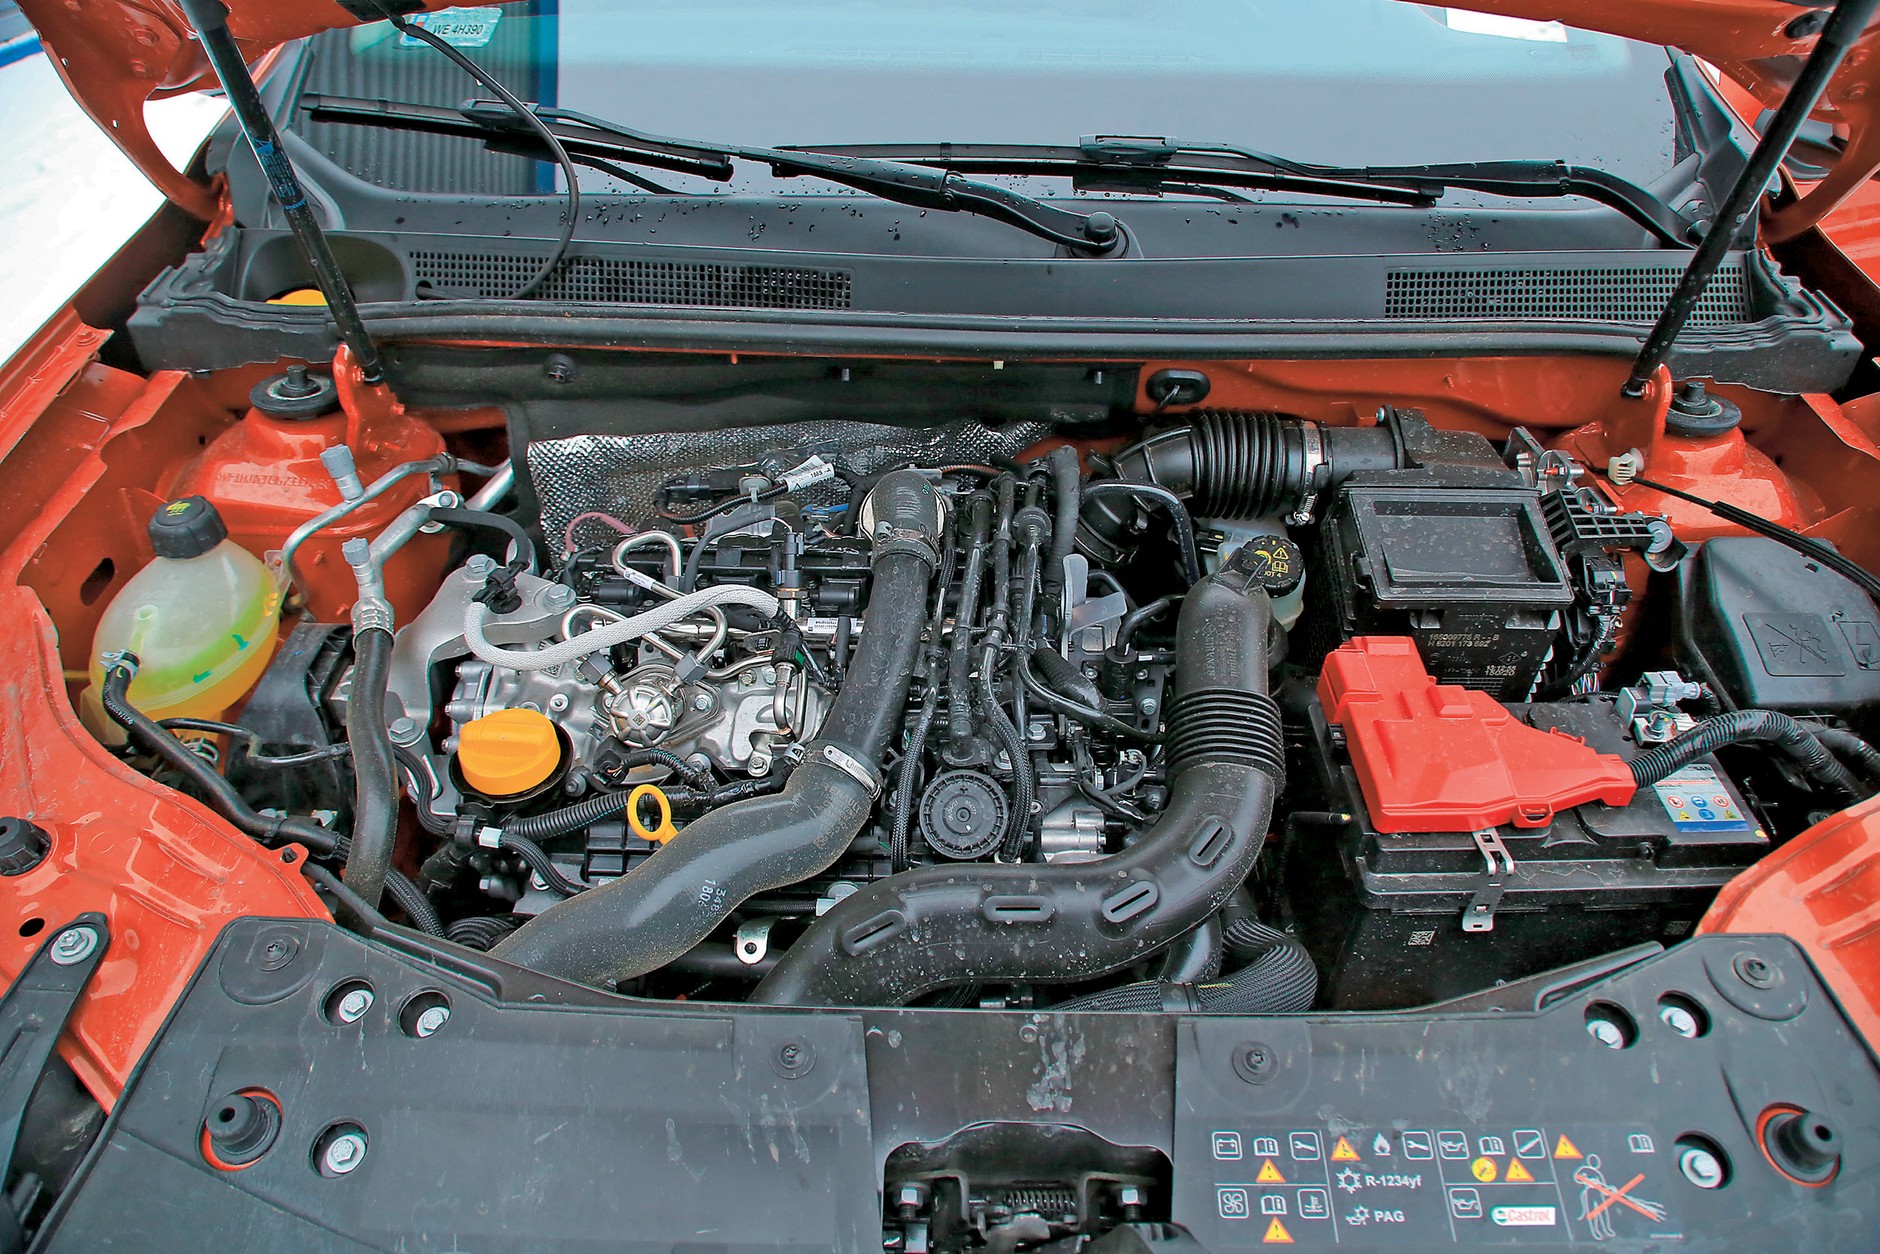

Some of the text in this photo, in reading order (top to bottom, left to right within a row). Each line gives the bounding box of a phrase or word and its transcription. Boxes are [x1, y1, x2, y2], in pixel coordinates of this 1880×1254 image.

[433, 24, 484, 34] WE 4H390
[1365, 1174, 1422, 1189] R-1234yf
[1374, 1210, 1405, 1222] PAG
[1508, 1209, 1550, 1222] Castrol
